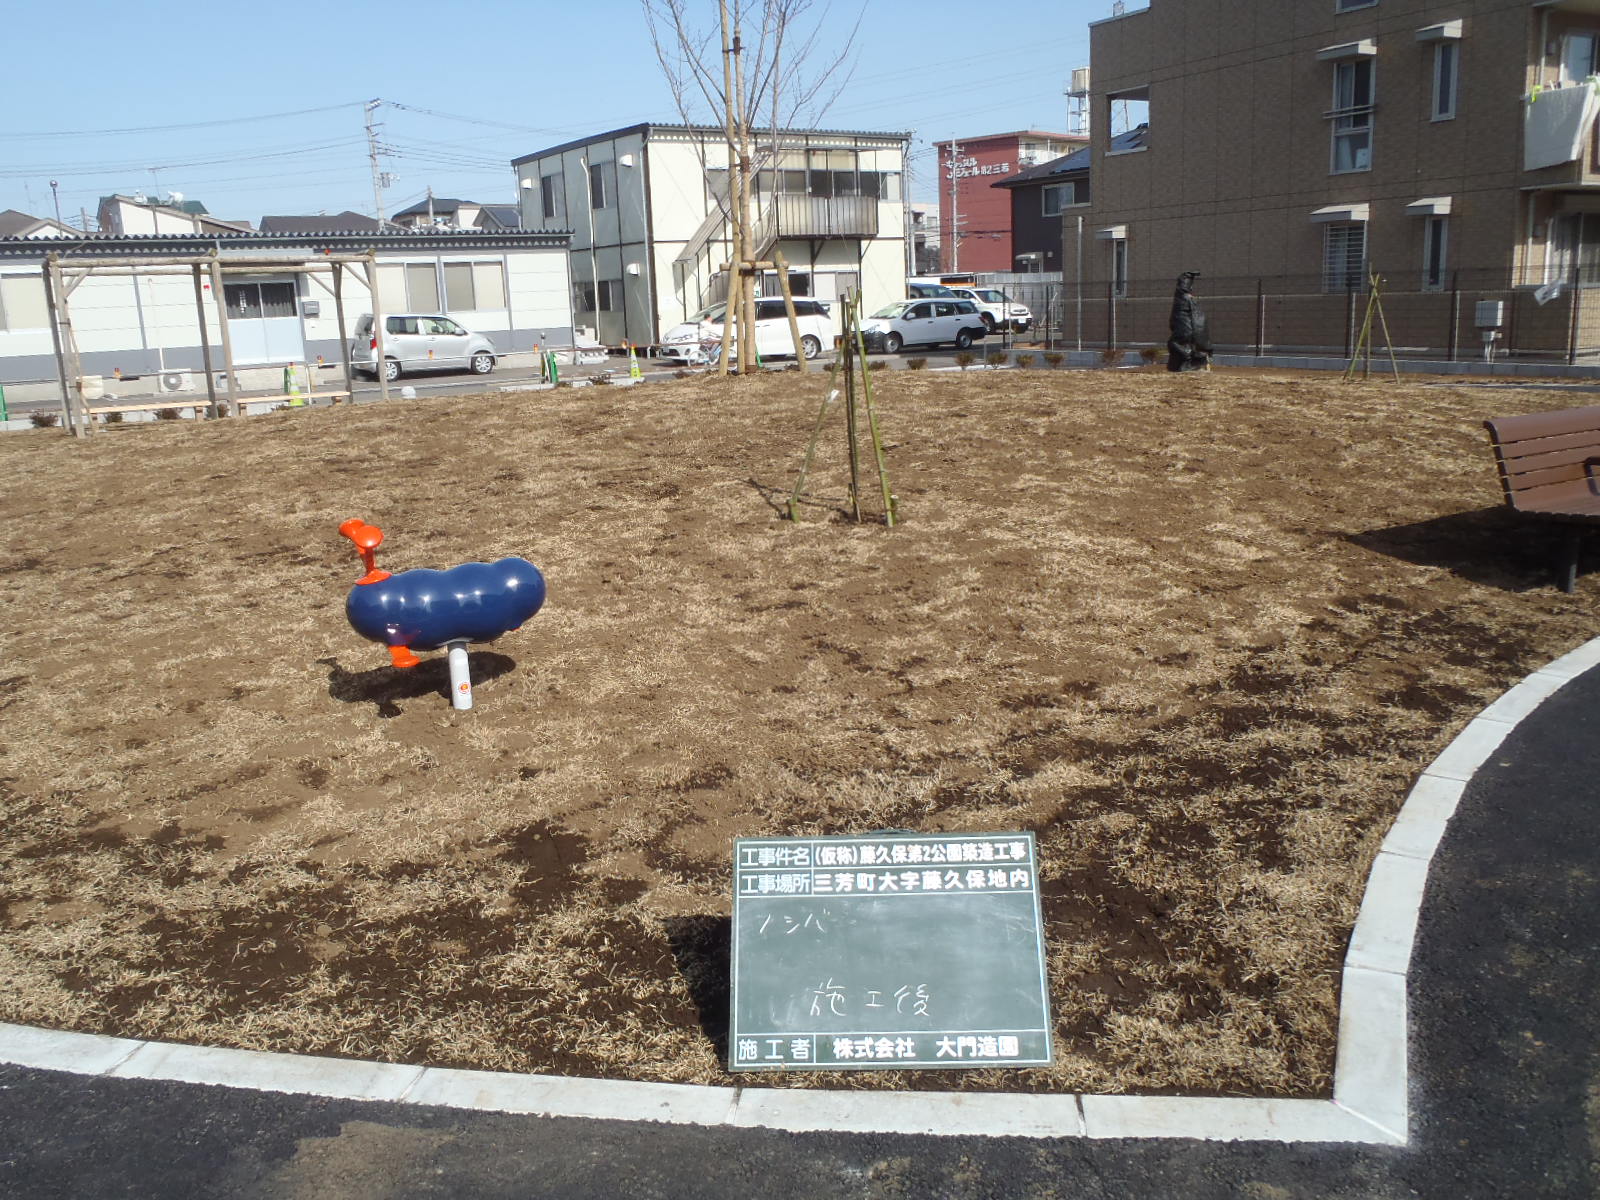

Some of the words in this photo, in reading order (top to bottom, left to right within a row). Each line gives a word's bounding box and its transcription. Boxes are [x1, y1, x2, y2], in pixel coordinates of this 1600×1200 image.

[741, 847, 810, 866] 工事件名
[815, 842, 1026, 864] (仮称)藤久保第2公園築造工事
[741, 873, 811, 893] 工事場所
[814, 869, 1029, 891] 三芳町大字藤久保地内
[760, 908, 830, 933] ノシバ
[809, 977, 930, 1017] 施工後
[738, 1038, 810, 1060] 施工者
[833, 1036, 916, 1059] 株式会社
[935, 1035, 1019, 1058] 大門造園
